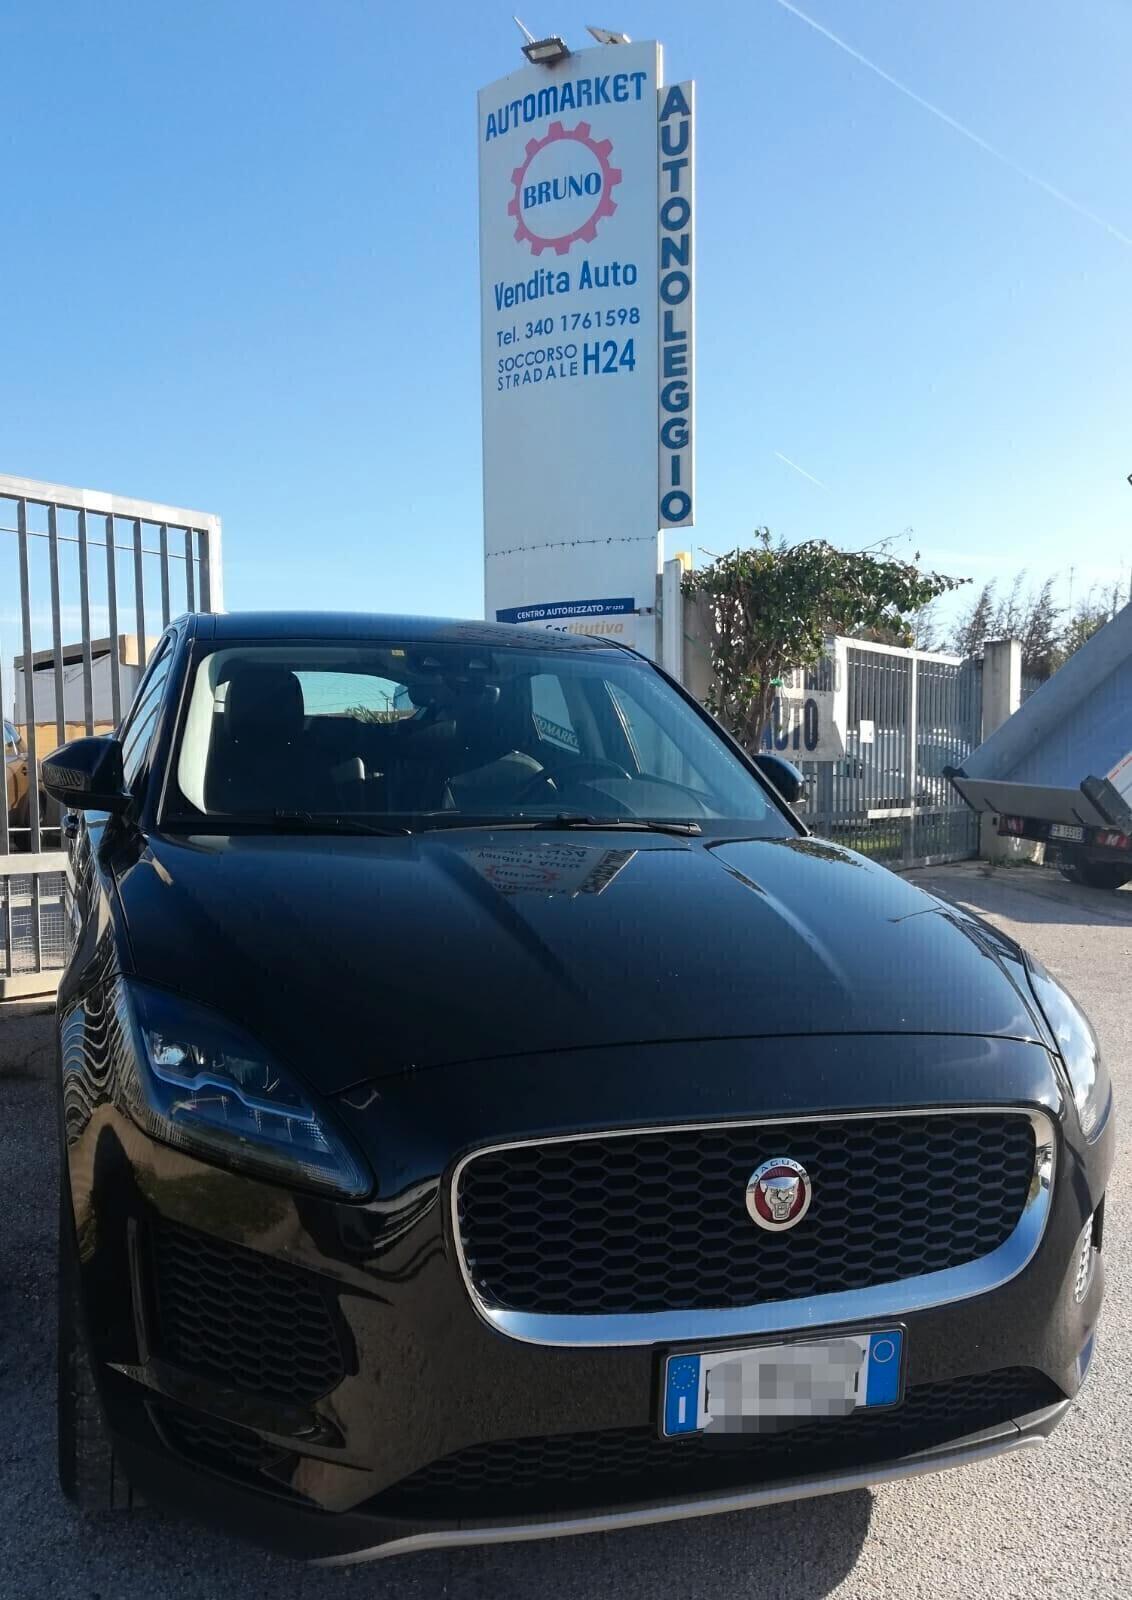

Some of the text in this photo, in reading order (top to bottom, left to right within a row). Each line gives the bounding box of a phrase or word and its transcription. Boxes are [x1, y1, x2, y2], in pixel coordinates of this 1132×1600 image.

[486, 72, 647, 142] AUTOMARKET
[523, 172, 602, 209] BRUNO
[494, 260, 638, 311] Vendita Auto
[658, 85, 691, 522] AUTONOLEGGIO
[496, 307, 640, 347] Tel. 340 1761598
[497, 344, 577, 374] SOCCORSO
[583, 338, 636, 375] H24
[497, 361, 578, 391] STRADALE
[517, 609, 545, 620] CENTRO
[546, 604, 604, 616] AUTORIZZATO
[751, 1159, 809, 1184] JAGUAR
